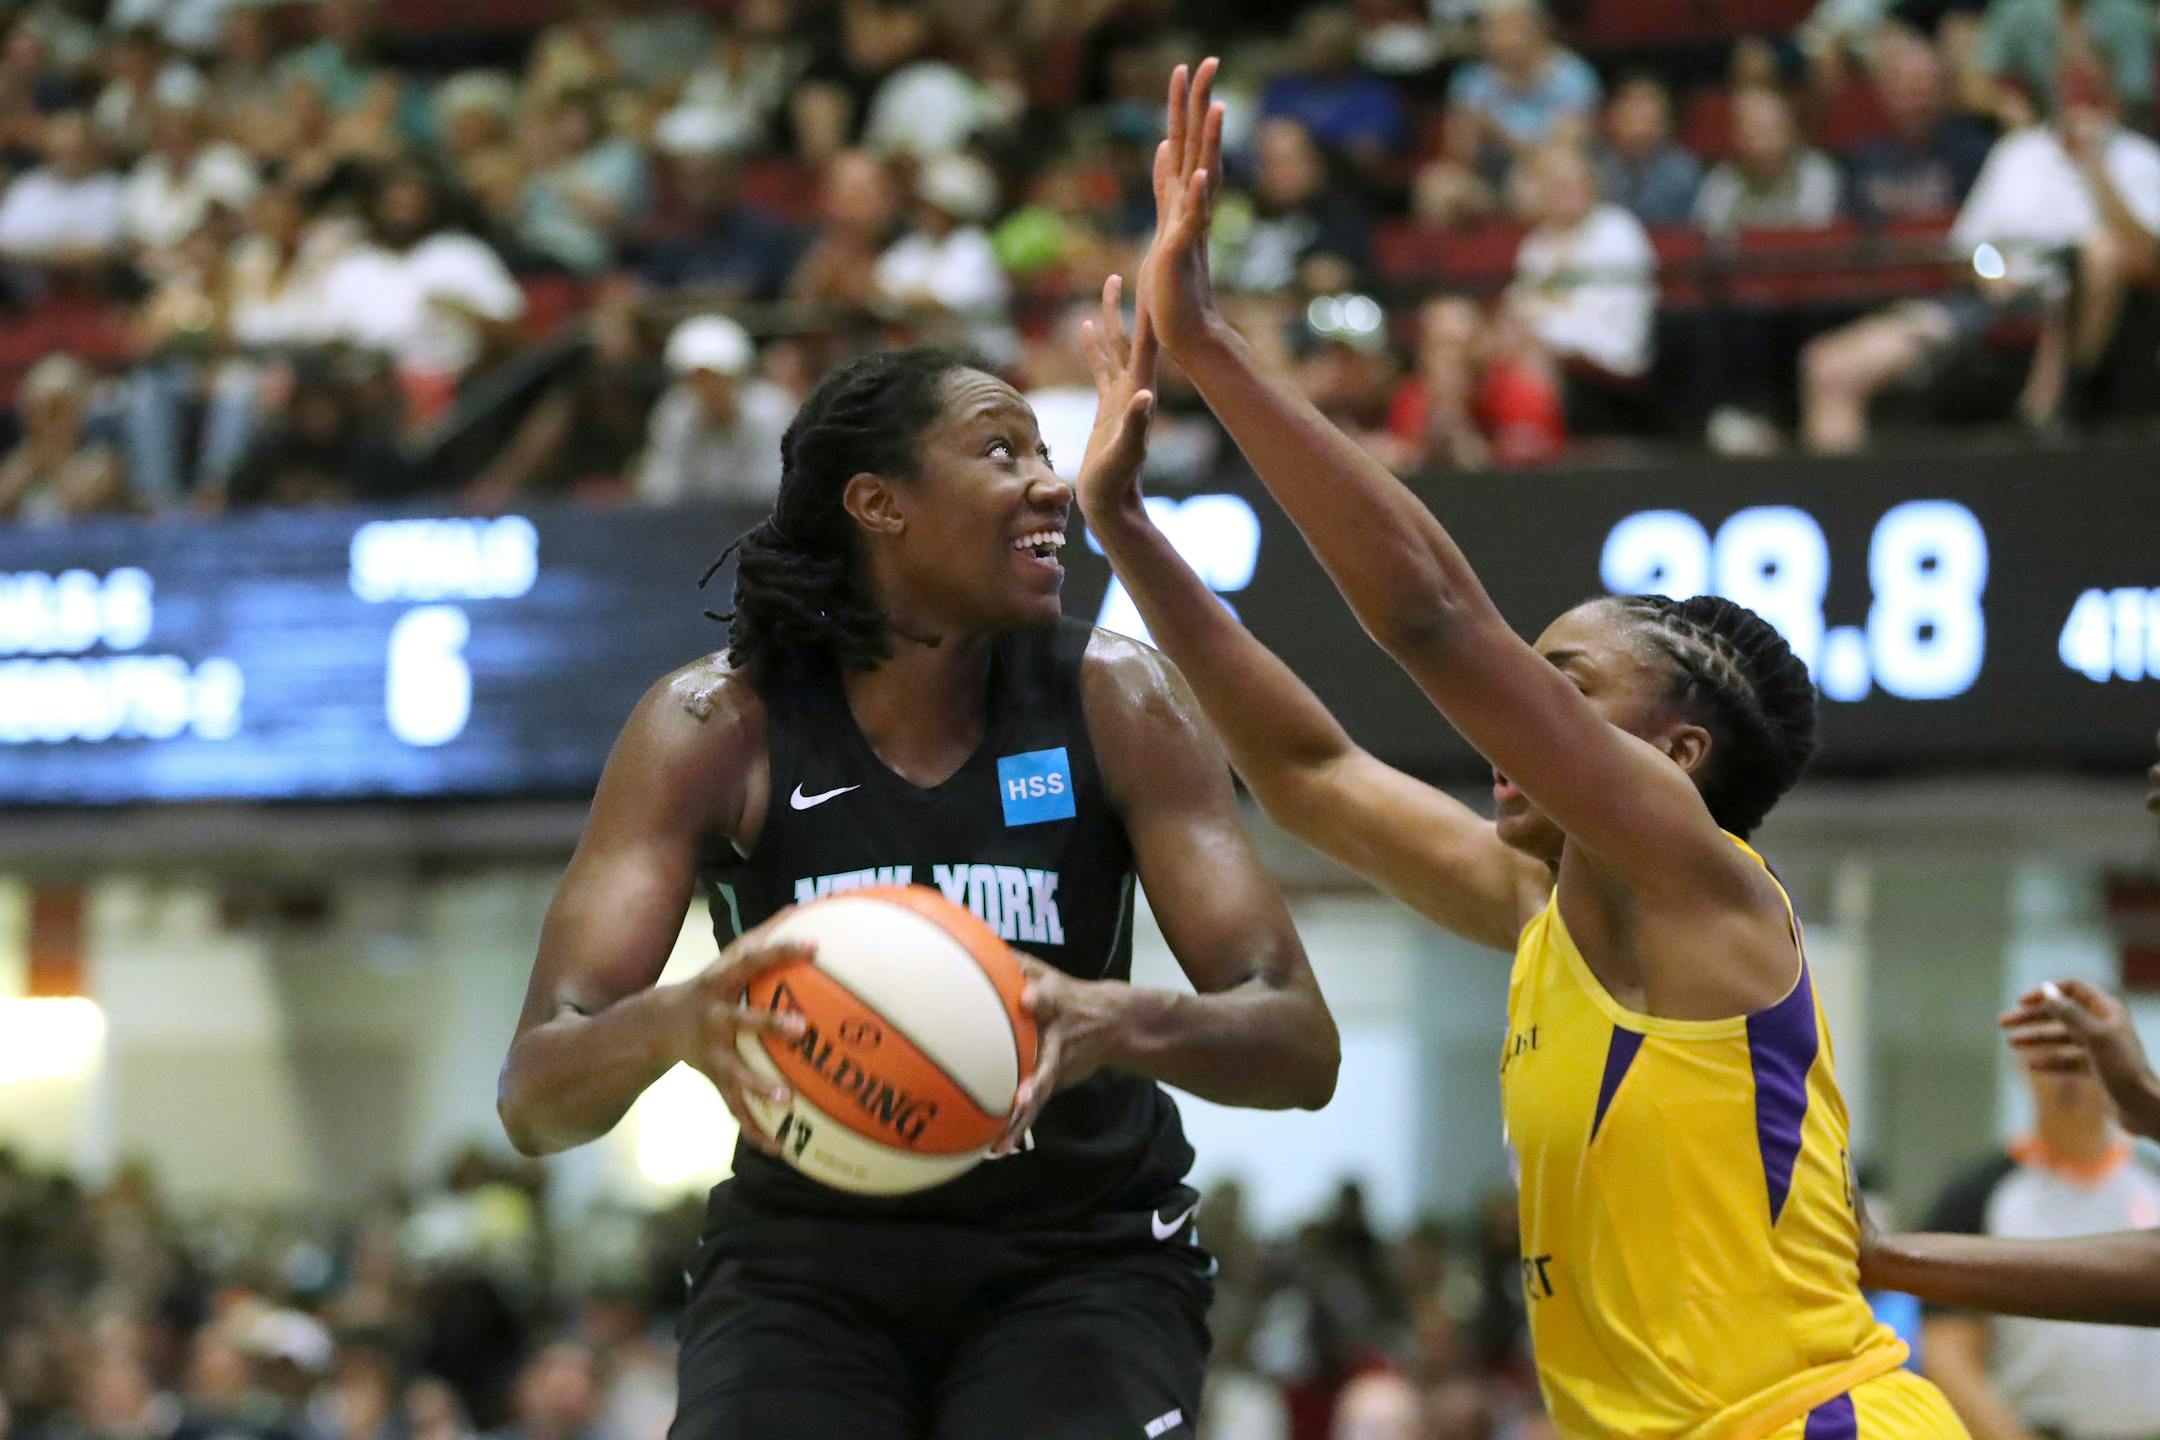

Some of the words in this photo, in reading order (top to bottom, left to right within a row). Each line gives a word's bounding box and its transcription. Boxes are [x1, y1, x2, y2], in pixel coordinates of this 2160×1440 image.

[386, 605, 471, 746] 6
[1008, 772, 1065, 801] HSS
[932, 863, 1066, 946] YORK
